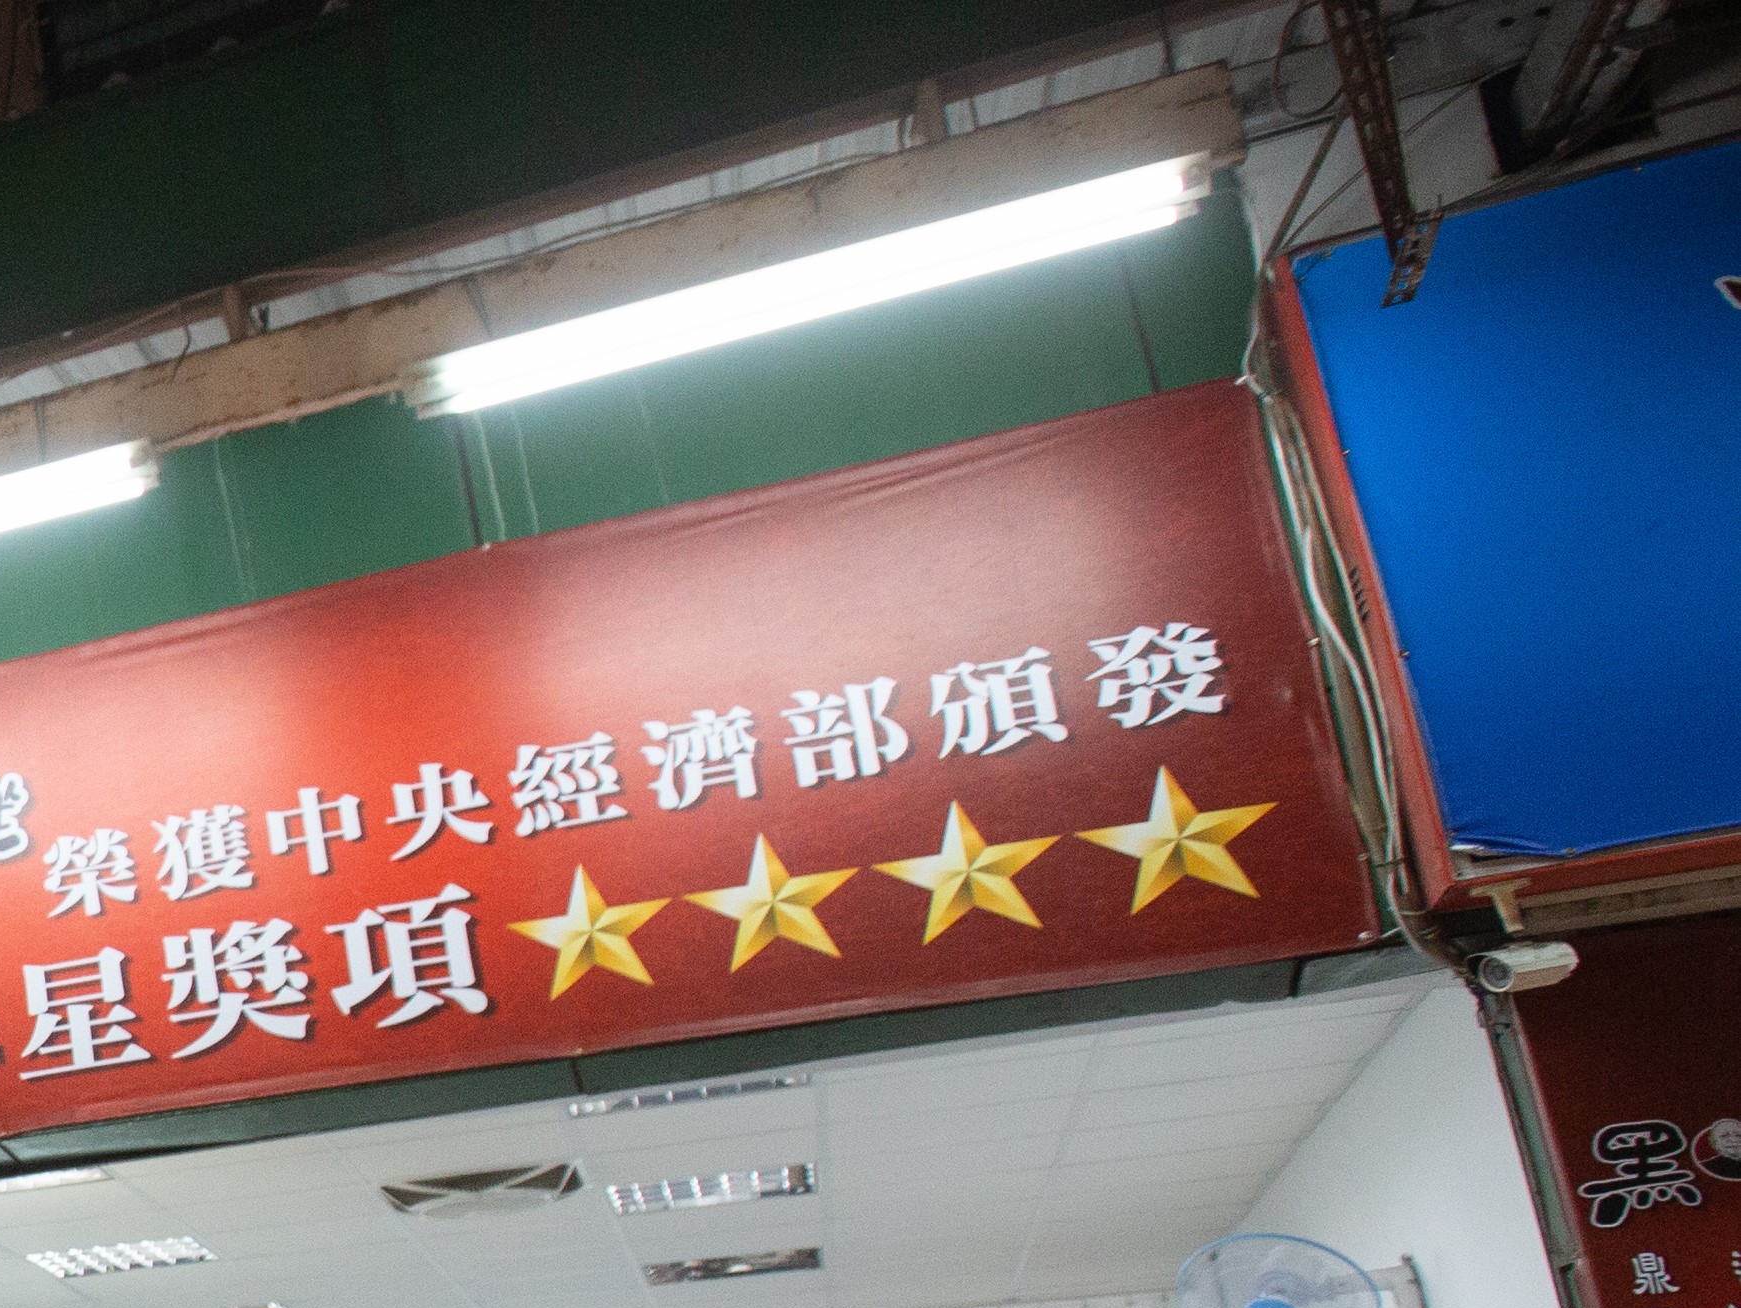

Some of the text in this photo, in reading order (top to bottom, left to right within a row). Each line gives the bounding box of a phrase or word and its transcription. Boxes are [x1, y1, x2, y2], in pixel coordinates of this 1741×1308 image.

[44, 623, 1227, 919] 榮獲中央經濟部頒發
